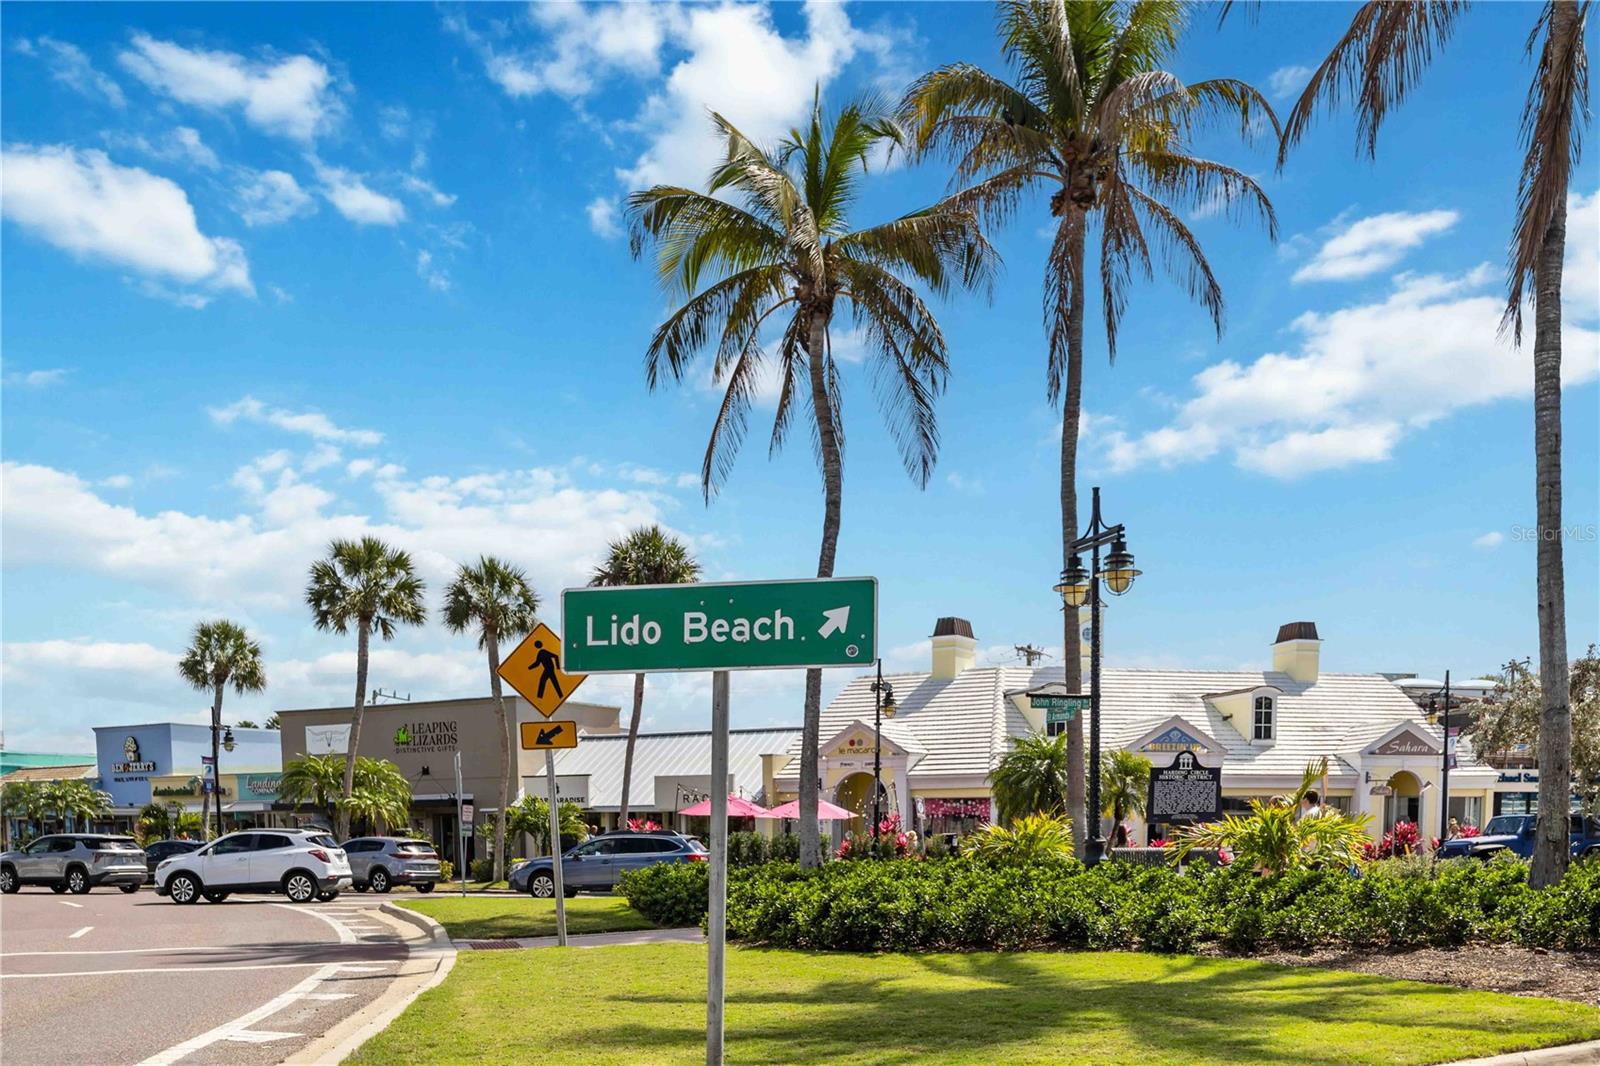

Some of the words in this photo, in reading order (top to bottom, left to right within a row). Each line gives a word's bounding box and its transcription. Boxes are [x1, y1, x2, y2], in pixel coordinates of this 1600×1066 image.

[586, 614, 662, 647] Lido
[683, 608, 795, 643] Beach
[1031, 697, 1049, 706] John
[1052, 698, 1081, 709] Ringling
[412, 721, 457, 735] LEAPING
[413, 733, 458, 746] LIZARDS
[396, 745, 434, 754] DISTINCTIVE
[437, 744, 456, 752] GIFTS
[1386, 740, 1429, 754] Sahara
